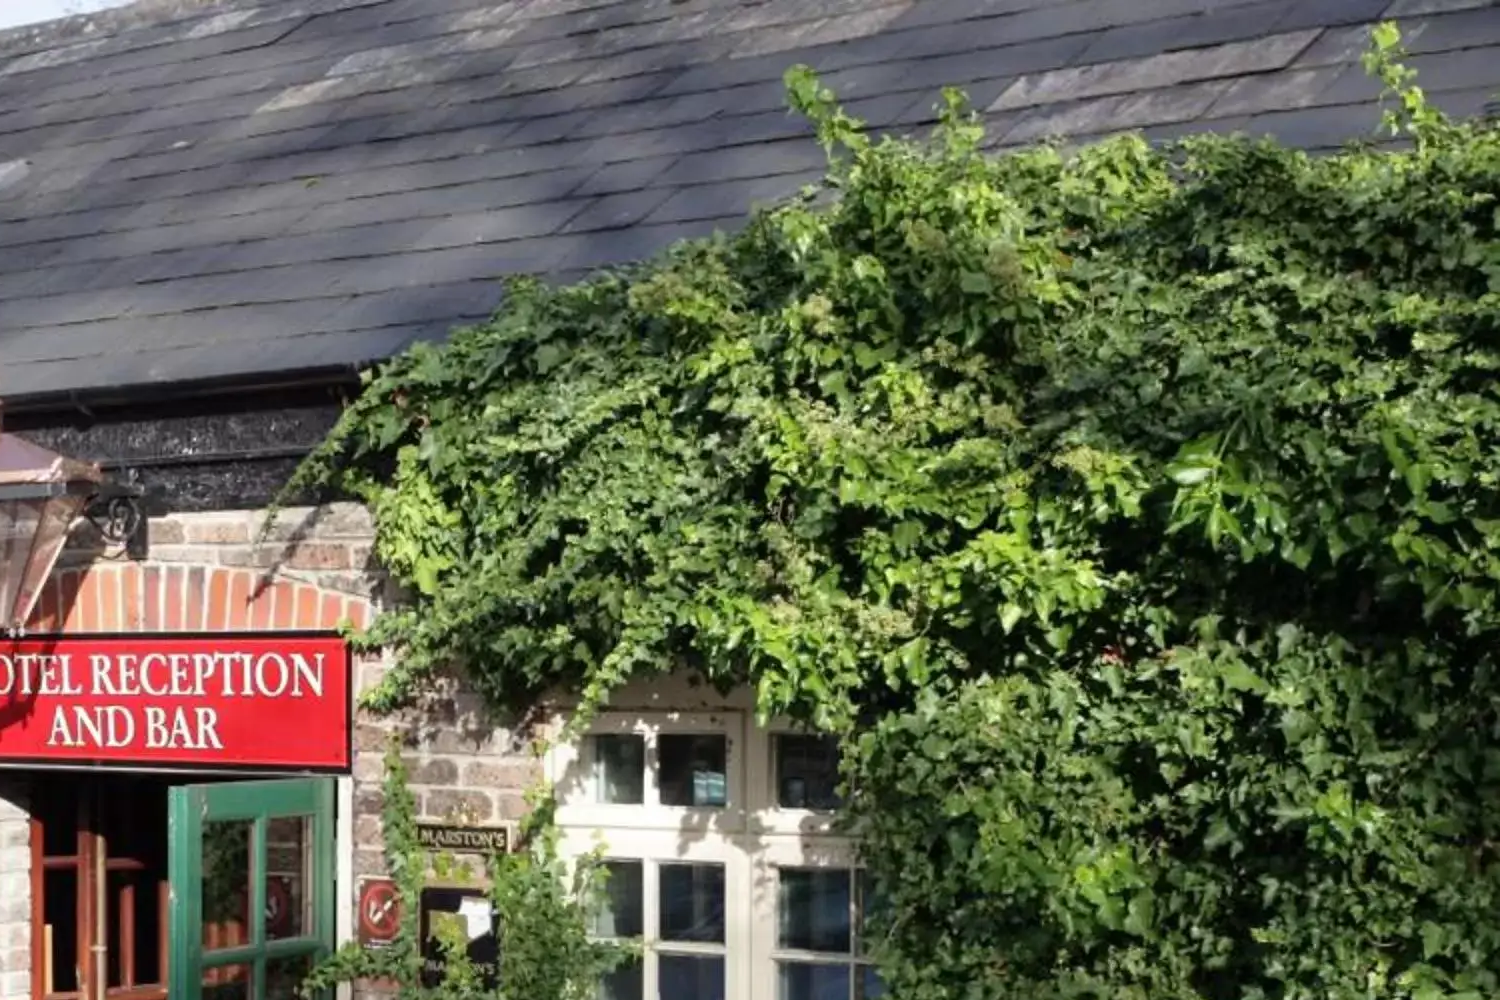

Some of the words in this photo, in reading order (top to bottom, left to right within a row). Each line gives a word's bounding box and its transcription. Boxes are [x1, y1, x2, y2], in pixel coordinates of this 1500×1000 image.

[89, 651, 325, 698] RECEPTION
[47, 704, 135, 748] AND
[144, 706, 224, 750] BAR
[421, 829, 504, 848] MARSTON'S
